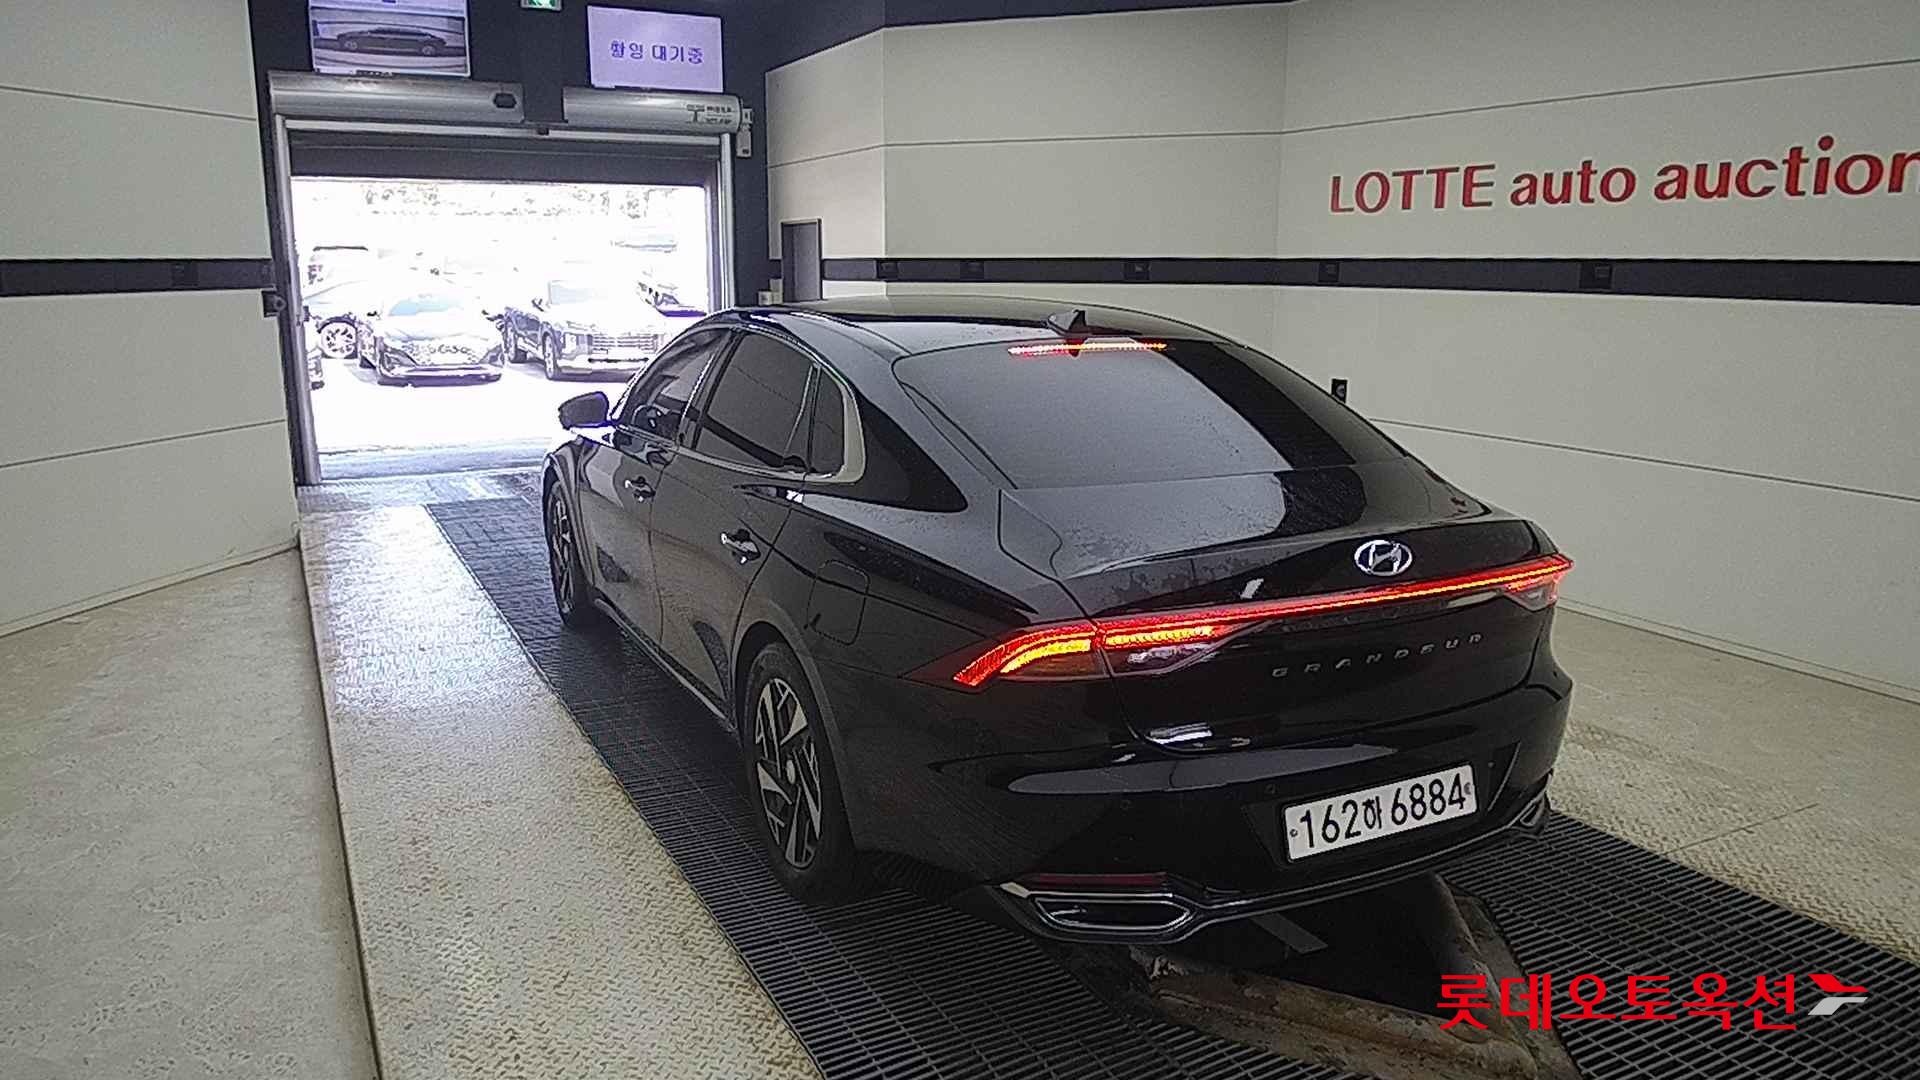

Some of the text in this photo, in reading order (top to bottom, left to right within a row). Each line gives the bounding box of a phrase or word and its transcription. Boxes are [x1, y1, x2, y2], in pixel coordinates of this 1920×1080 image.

[651, 45, 703, 64] 대기중
[1331, 164, 1496, 213] LOTTE
[1510, 159, 1636, 206] auto
[1271, 634, 1482, 677] GRANDEUR
